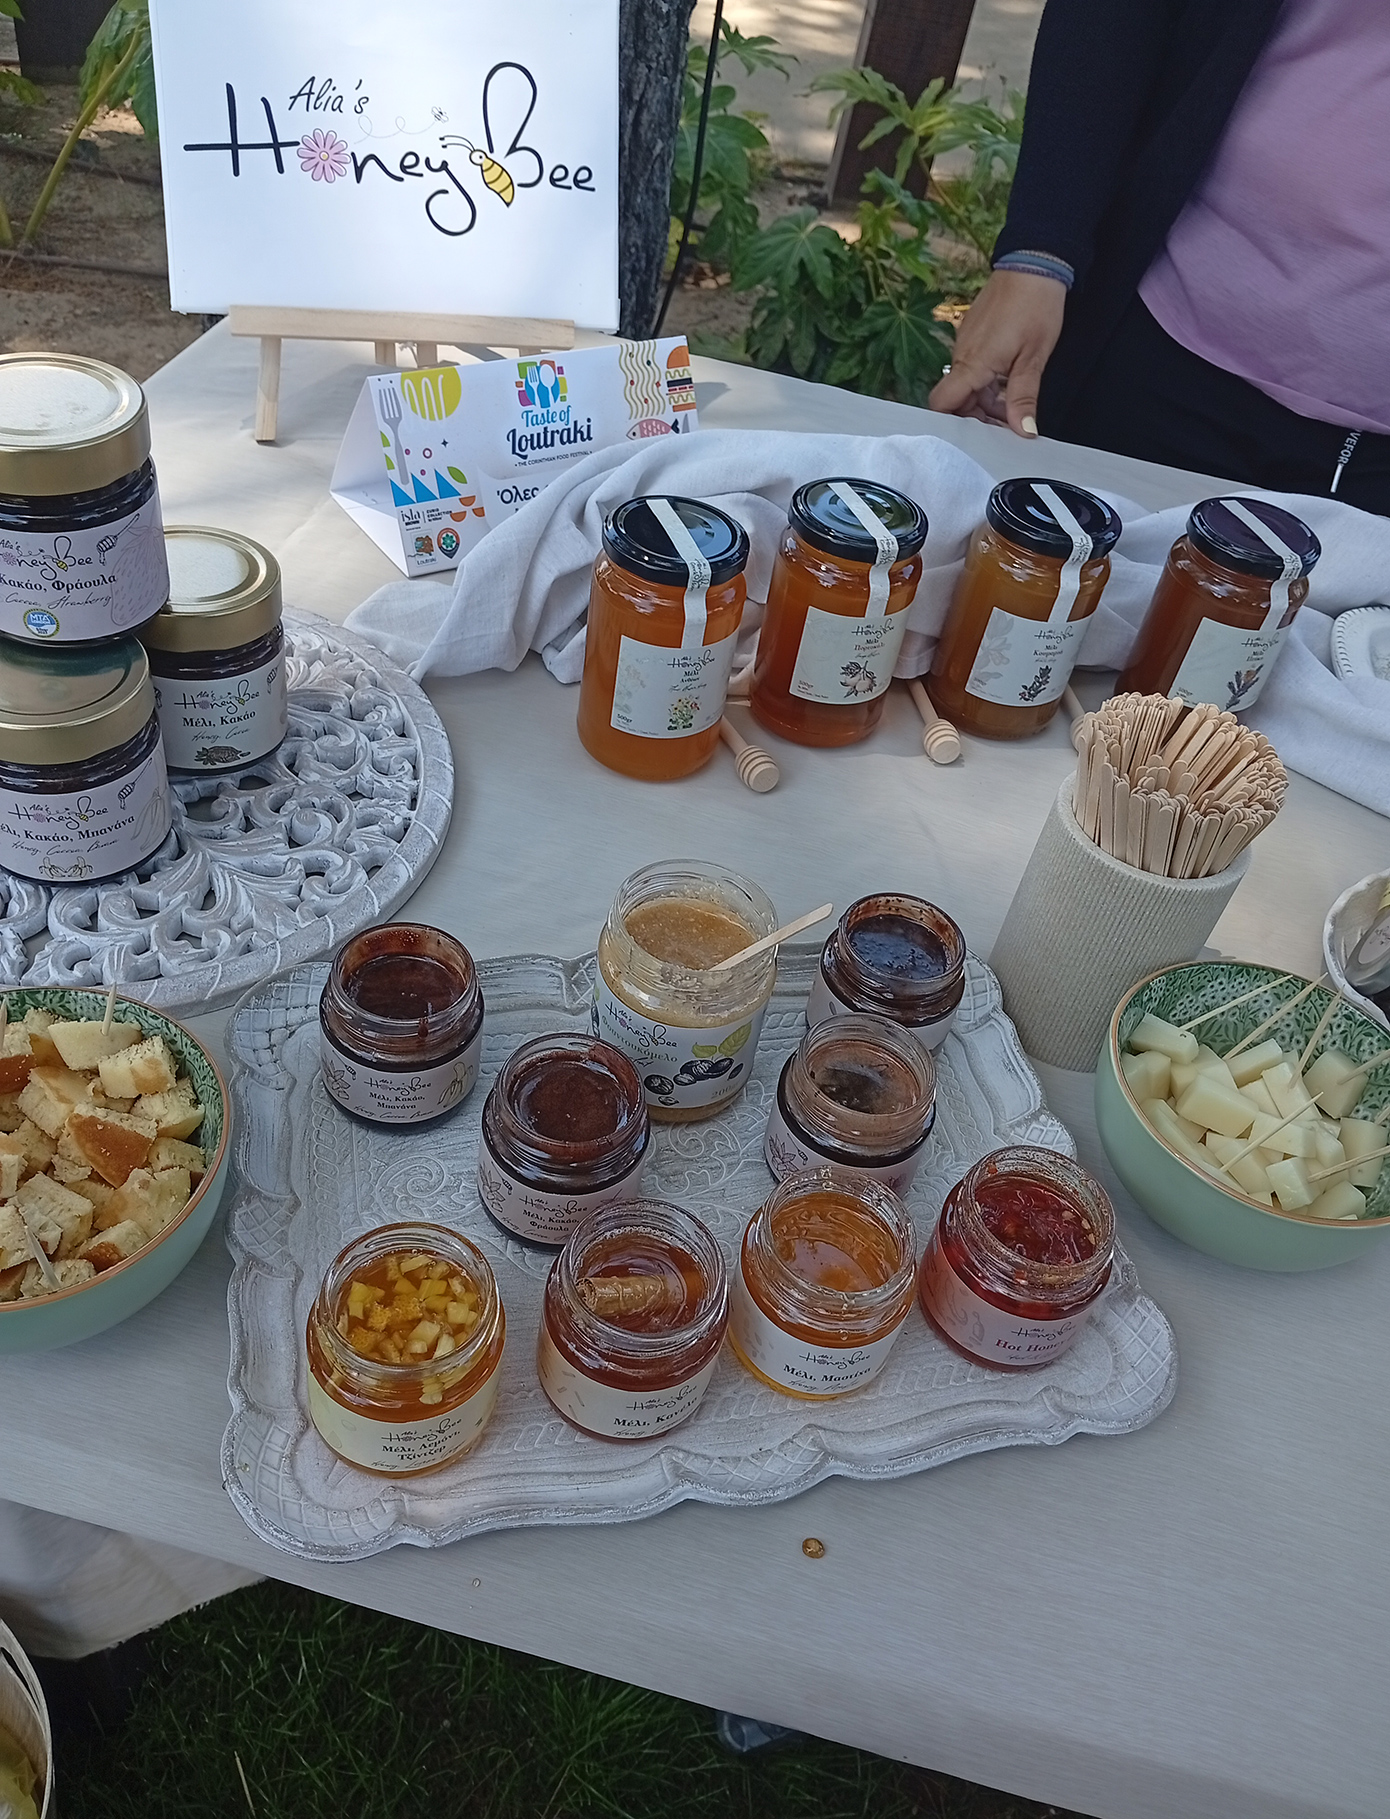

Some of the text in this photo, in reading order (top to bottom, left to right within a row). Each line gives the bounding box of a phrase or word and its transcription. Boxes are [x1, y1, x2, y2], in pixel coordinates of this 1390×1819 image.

[288, 75, 370, 115] Alia's
[481, 61, 596, 193] Bee
[521, 404, 572, 428] Taste of
[506, 417, 594, 461] Loutraki
[556, 453, 569, 461] FOOD
[54, 535, 94, 568] Bee
[51, 574, 118, 594] Φράουλα
[182, 710, 256, 728] Μέλι, Κακάο
[0, 815, 136, 843] έλι, Κακάο, Μπανάνα
[995, 1338, 1022, 1351] Hot
[782, 1364, 818, 1382] Μέλι,
[613, 1417, 651, 1427] Μέλι,
[382, 1445, 415, 1453] Μέλι,
